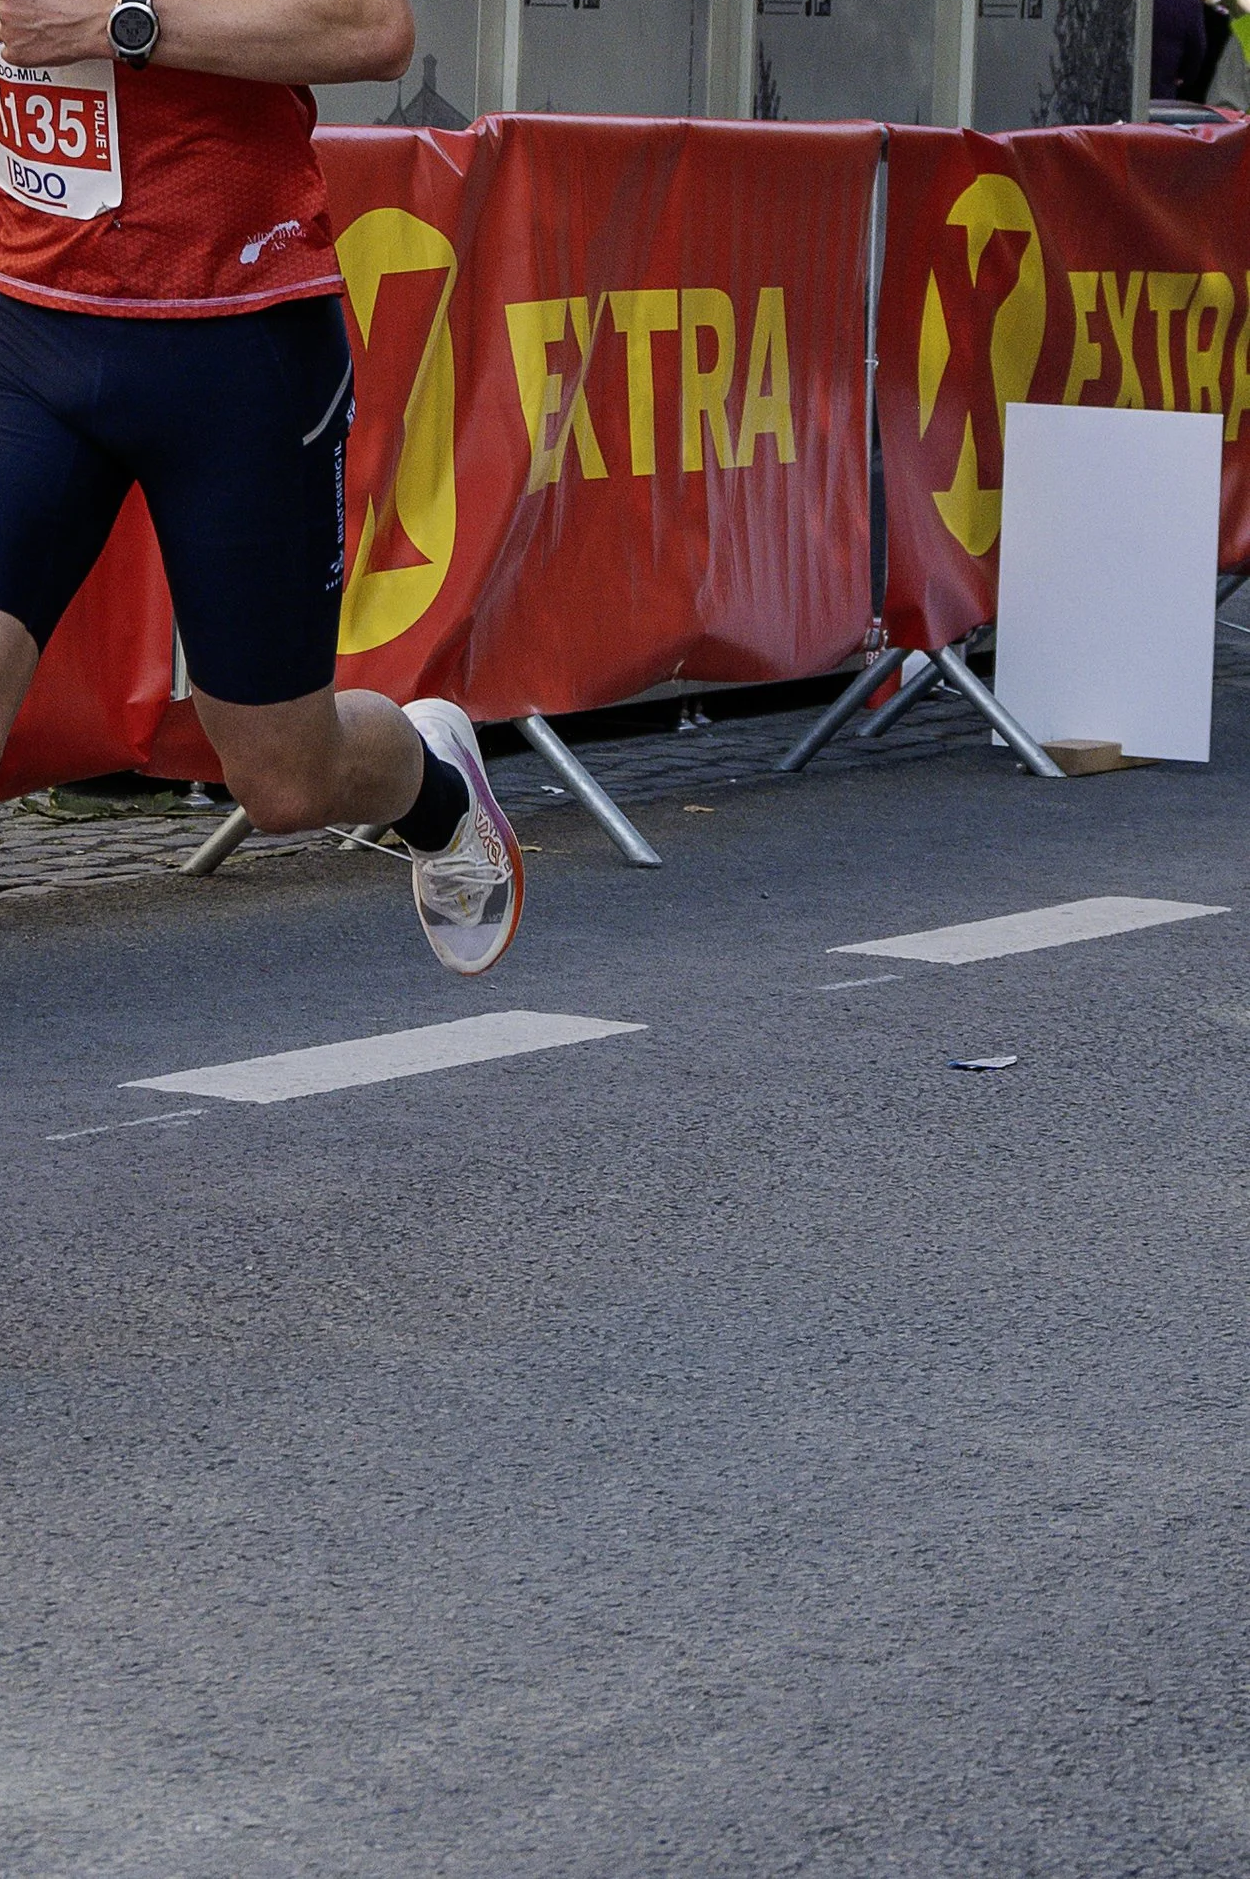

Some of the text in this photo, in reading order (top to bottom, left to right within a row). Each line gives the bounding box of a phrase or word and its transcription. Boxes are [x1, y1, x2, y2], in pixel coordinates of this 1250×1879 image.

[93, 100, 107, 148] PULJE
[11, 159, 66, 199] BDO
[505, 287, 796, 496] EXTRA
